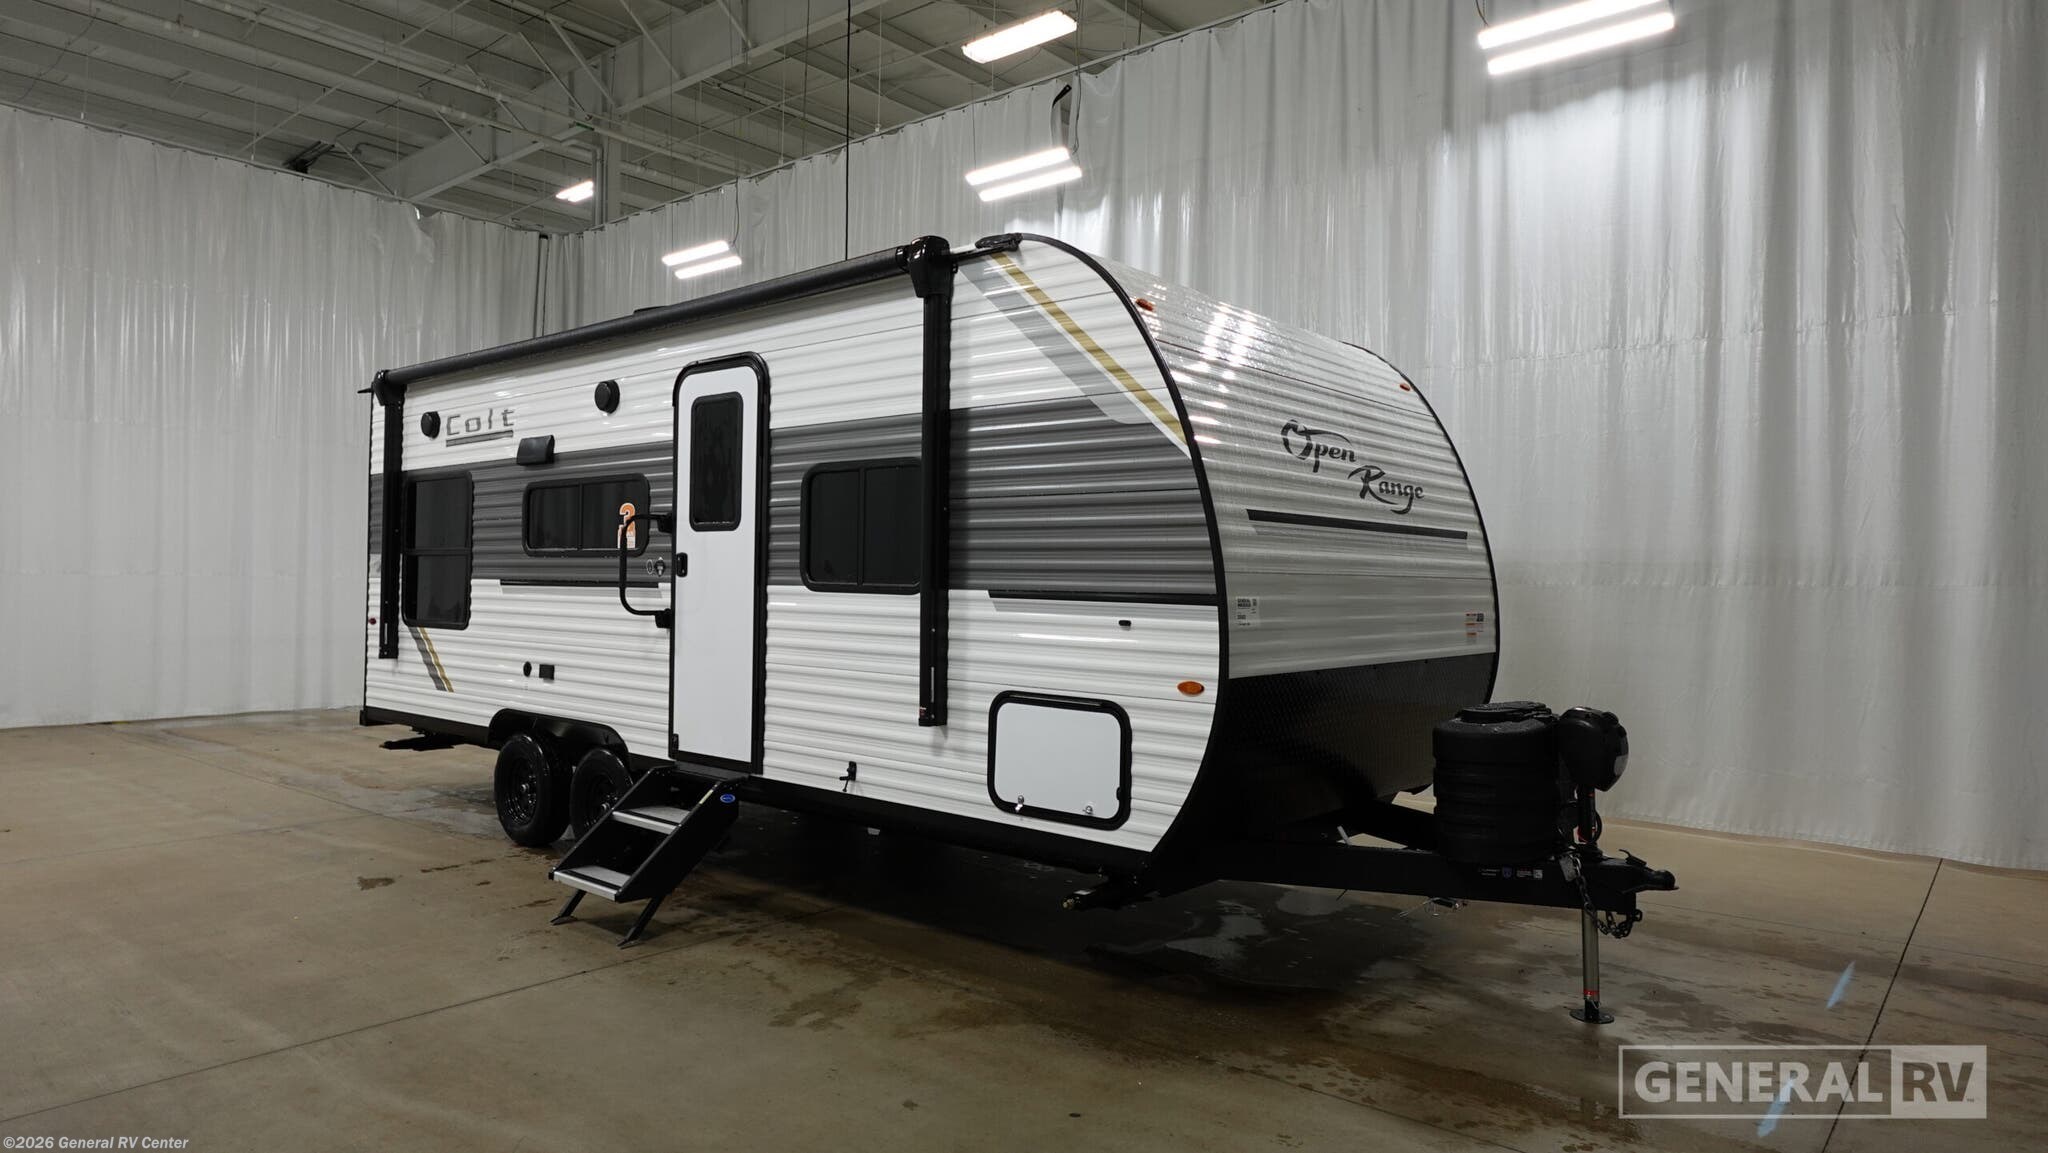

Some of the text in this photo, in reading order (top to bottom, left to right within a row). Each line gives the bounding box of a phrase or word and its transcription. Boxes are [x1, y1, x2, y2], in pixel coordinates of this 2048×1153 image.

[446, 408, 516, 436] Colt
[1281, 419, 1357, 473] Open
[1347, 465, 1425, 514] Range
